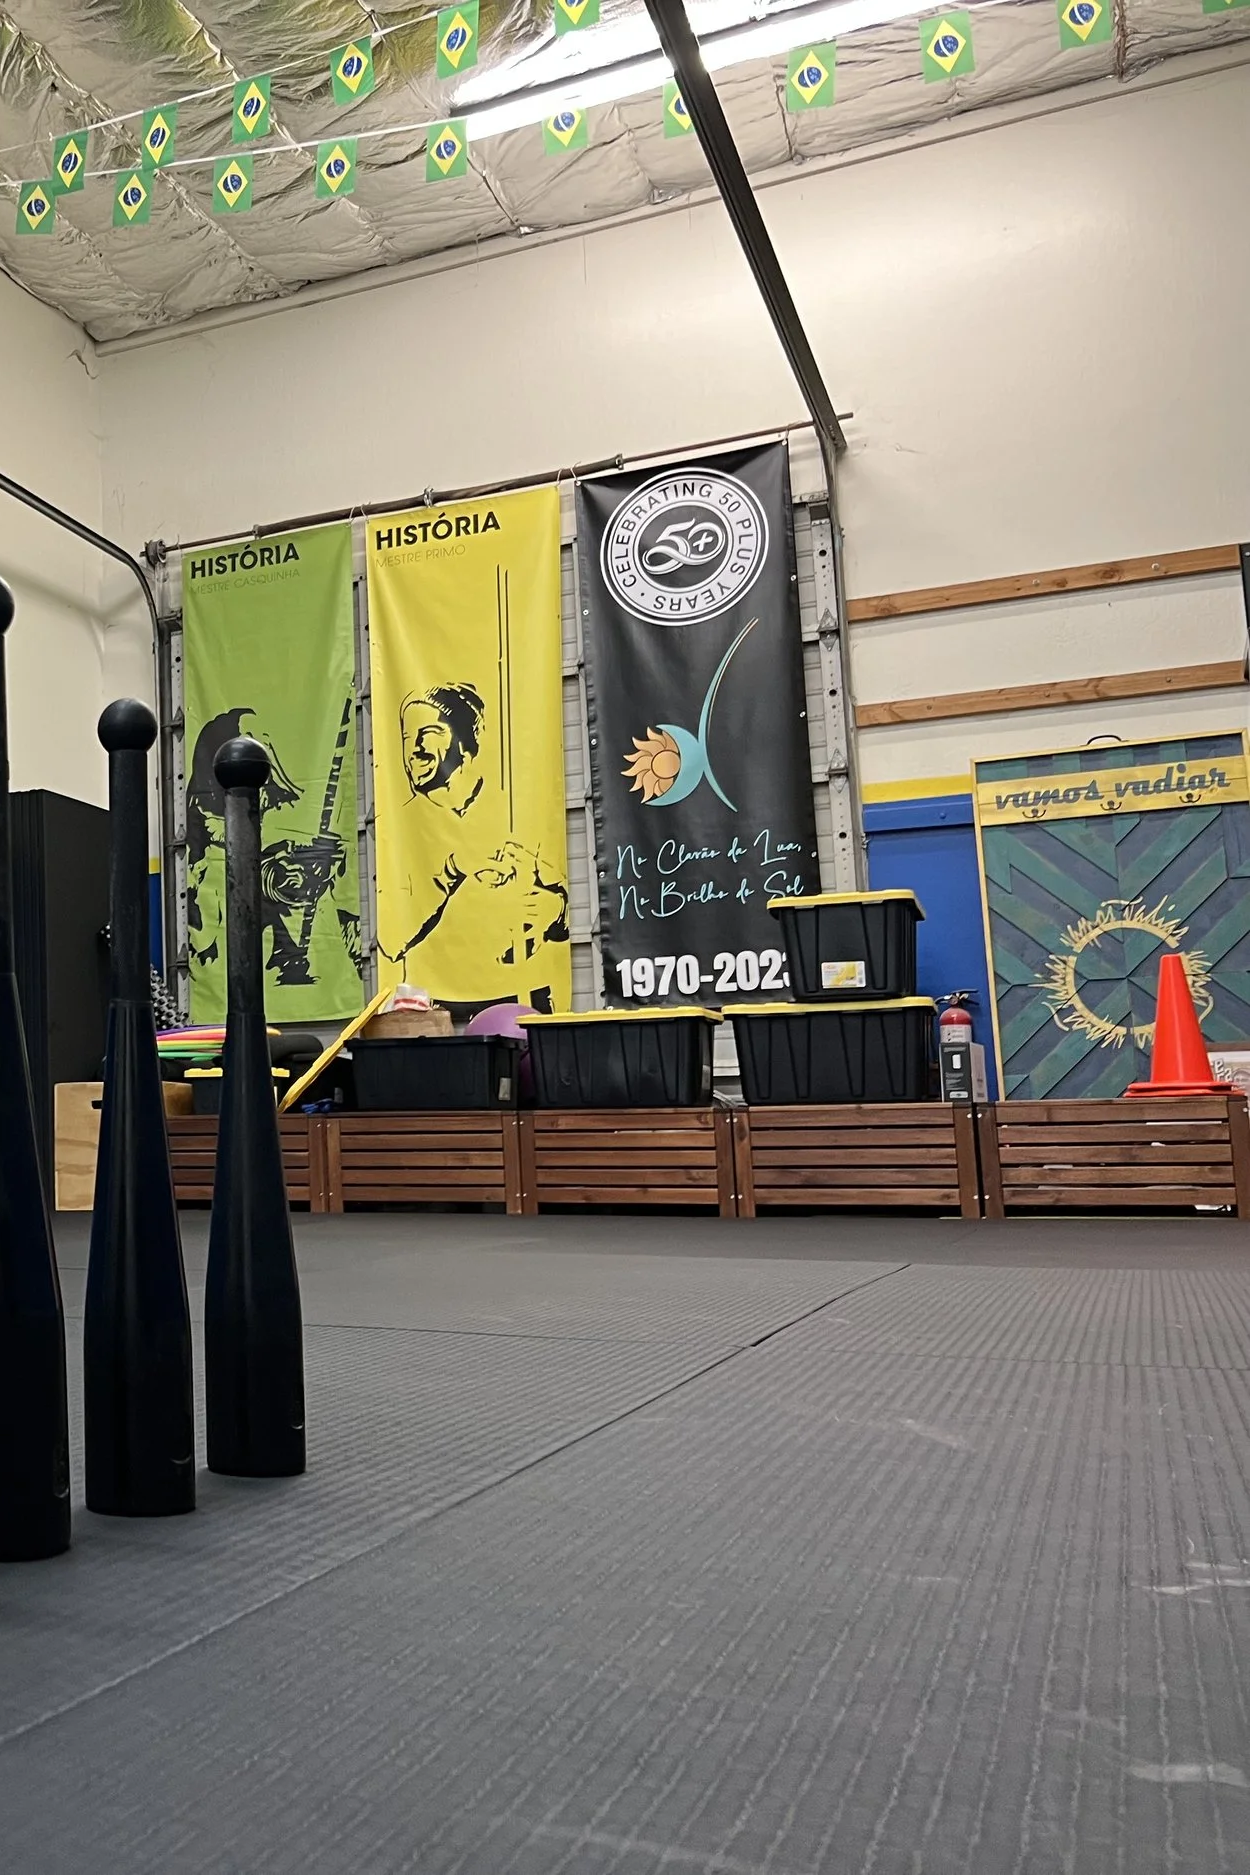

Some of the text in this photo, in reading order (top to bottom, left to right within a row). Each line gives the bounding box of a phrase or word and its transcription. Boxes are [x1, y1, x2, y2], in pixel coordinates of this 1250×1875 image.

[376, 511, 500, 551] HISTÓRIA
[615, 482, 754, 611] CELEBRATING 50 PLUS YEARS
[190, 542, 299, 579] HISTÓRIA
[375, 543, 466, 568] MESTRE PRIMO
[190, 568, 300, 595] MESTRE CASQUINHA
[995, 763, 1231, 810] vamos vadiar
[617, 844, 647, 879] No
[727, 836, 747, 863] da
[753, 828, 802, 866] Lua,
[619, 870, 805, 920] No Brilho do Sol
